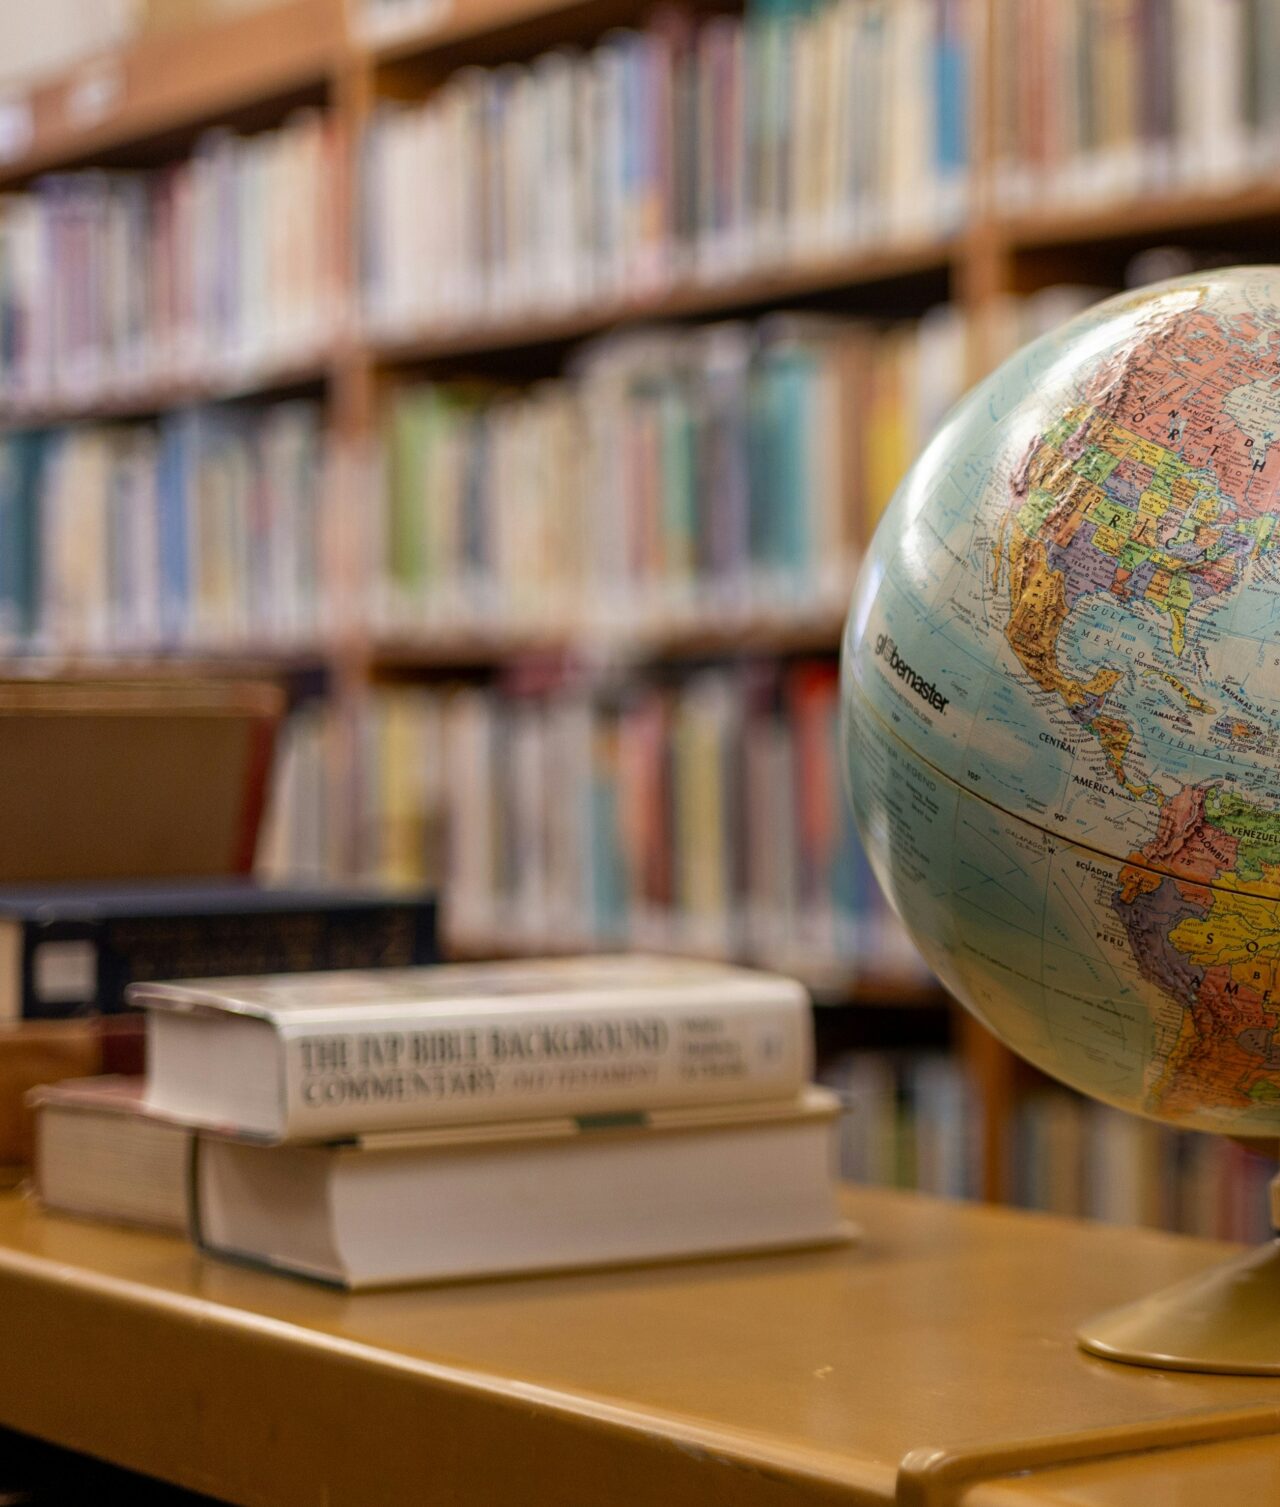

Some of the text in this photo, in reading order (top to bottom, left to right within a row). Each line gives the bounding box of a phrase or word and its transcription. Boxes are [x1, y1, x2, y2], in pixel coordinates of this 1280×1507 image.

[1182, 405, 1220, 425] MANITOBA
[1071, 559, 1090, 572] TEXAS
[1091, 604, 1155, 633] GULF OF
[1081, 629, 1145, 658] MEXICO
[1133, 658, 1163, 675] Havana
[1164, 675, 1192, 699] CUBA
[1221, 684, 1253, 710] BAHAMAS
[1105, 700, 1127, 710] BELIZE
[1157, 689, 1189, 719] GREATER
[1150, 709, 1180, 722] JAMAICA
[1172, 723, 1196, 735] Kingston
[1039, 732, 1075, 755] CENTRAL
[1140, 717, 1279, 779] CARIBBEAN SEA
[1072, 775, 1115, 796] AMERICA
[1054, 813, 1067, 822] 90°
[1193, 825, 1229, 866] COLOMBIA
[1076, 861, 1114, 879] ECUADOR
[1180, 857, 1194, 866] 75°
[1096, 932, 1125, 948] PERU
[301, 1033, 349, 1074] THE
[361, 1030, 405, 1070] IVP
[413, 1025, 480, 1067] BIBLE
[492, 1017, 669, 1062] BACKGROUND
[303, 1068, 497, 1107] COMMENTARY
